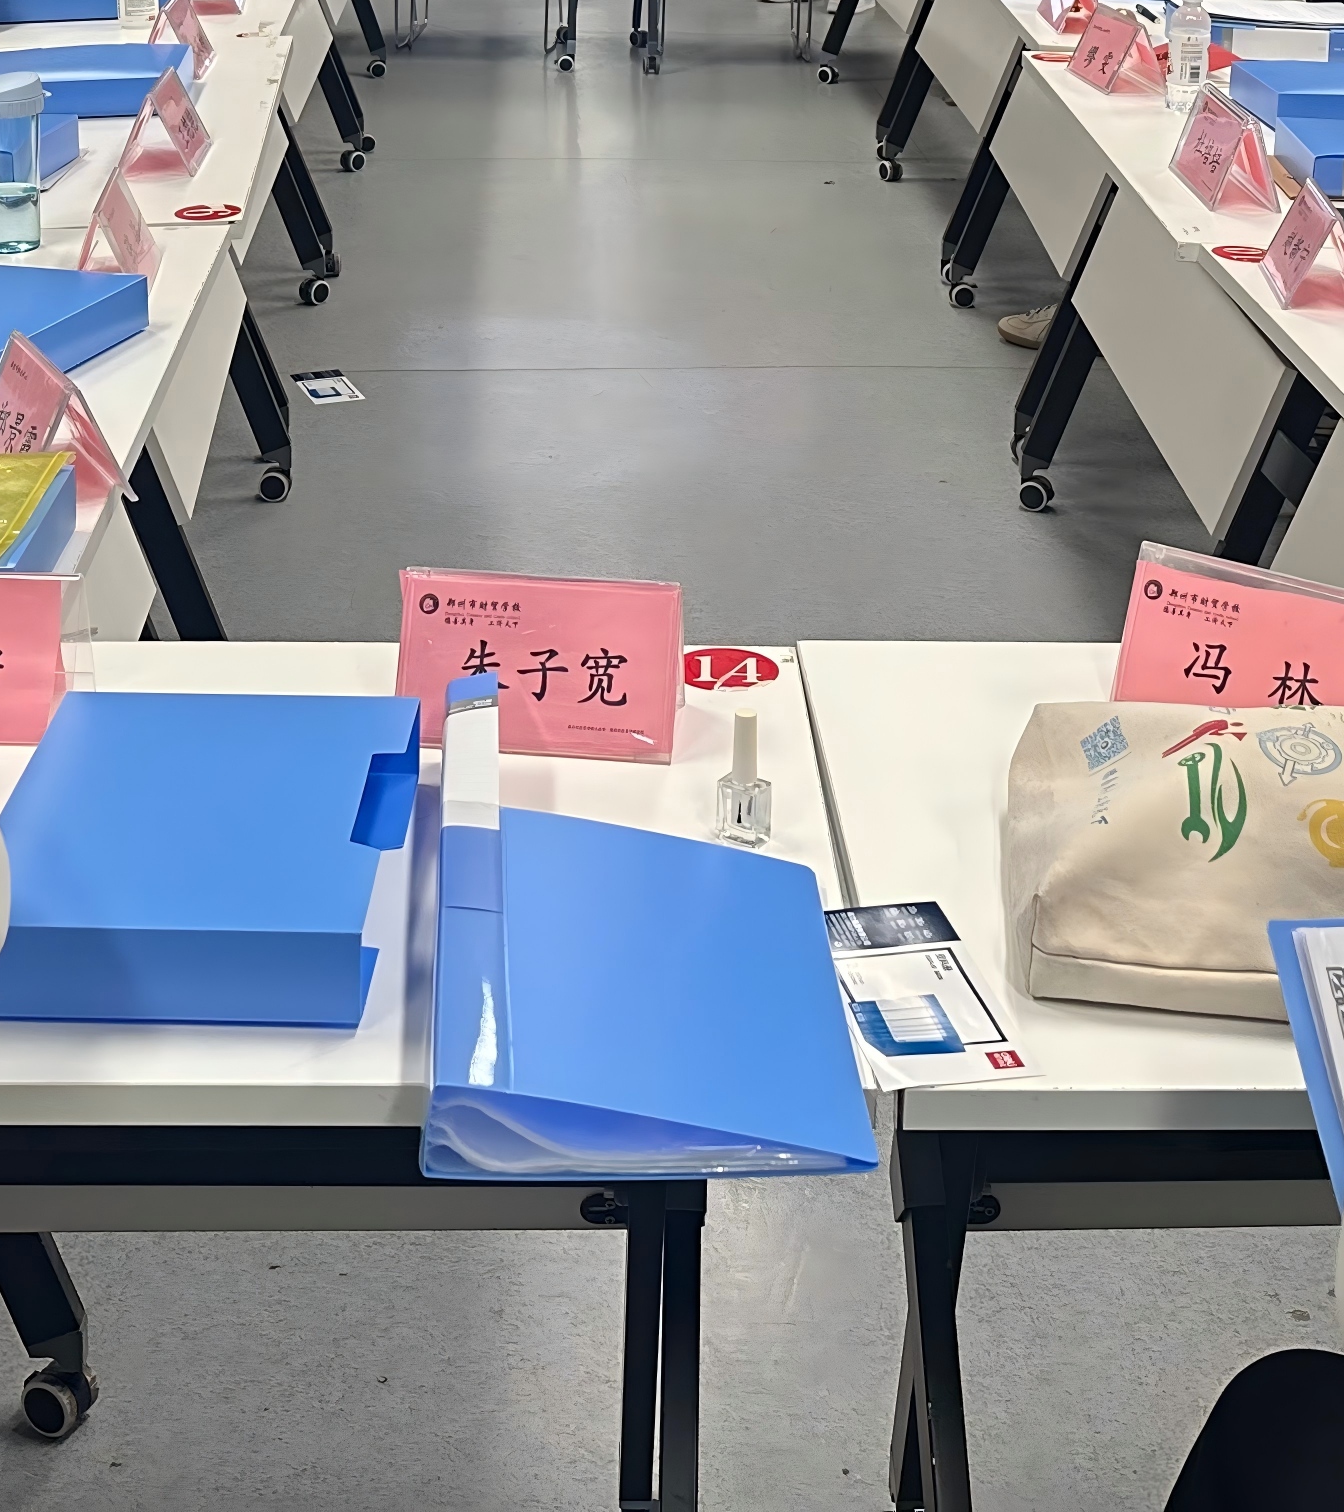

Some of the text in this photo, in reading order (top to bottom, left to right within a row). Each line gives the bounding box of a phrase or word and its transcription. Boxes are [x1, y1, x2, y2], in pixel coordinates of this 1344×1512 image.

[460, 639, 629, 707] 朱子宽
[1183, 642, 1325, 706] 冯林
